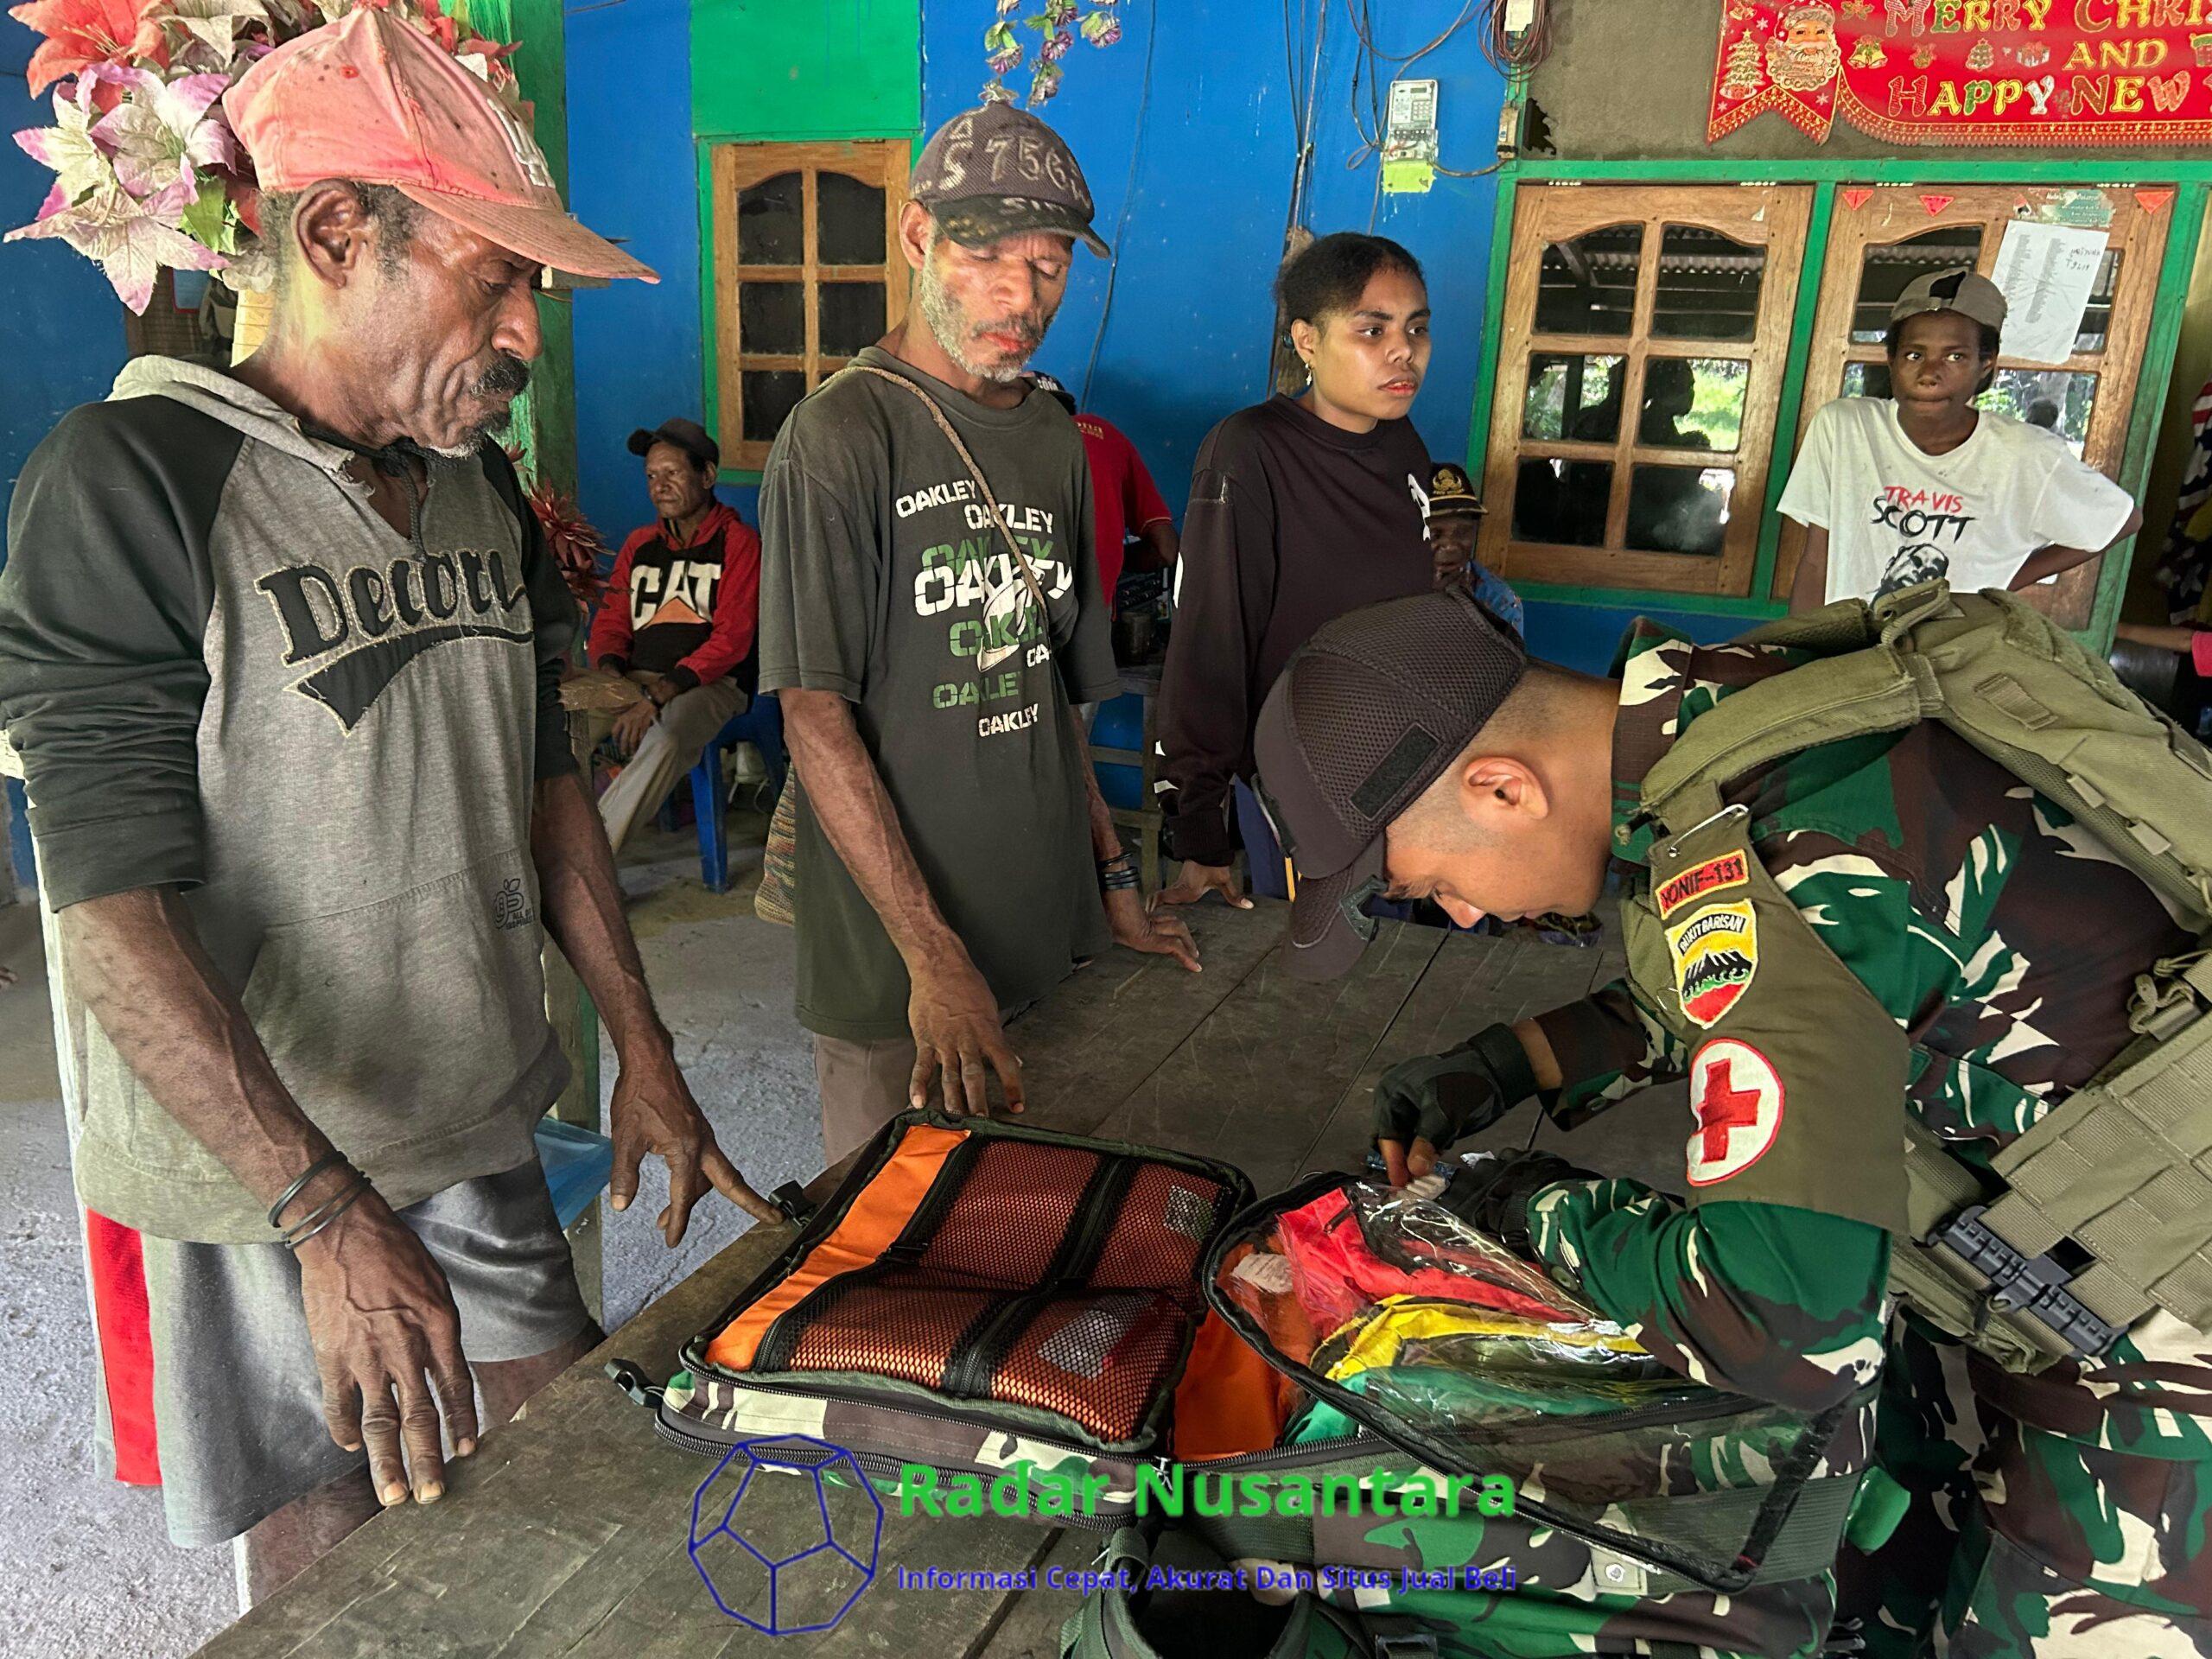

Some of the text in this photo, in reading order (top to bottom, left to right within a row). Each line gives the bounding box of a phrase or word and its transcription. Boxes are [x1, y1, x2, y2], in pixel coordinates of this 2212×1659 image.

[1885, 0, 2052, 37] MERRY
[2063, 38, 2169, 71] AND
[1887, 74, 2055, 117] HAPPY
[2070, 70, 2191, 116] NEW
[895, 480, 976, 518] OAKLEY
[1883, 486, 1964, 514] TRAVIS
[1870, 495, 1979, 543] SCOTT
[630, 560, 721, 632] CAT
[978, 703, 1039, 737] OAKLEY
[1661, 857, 1744, 907] YONIF-131
